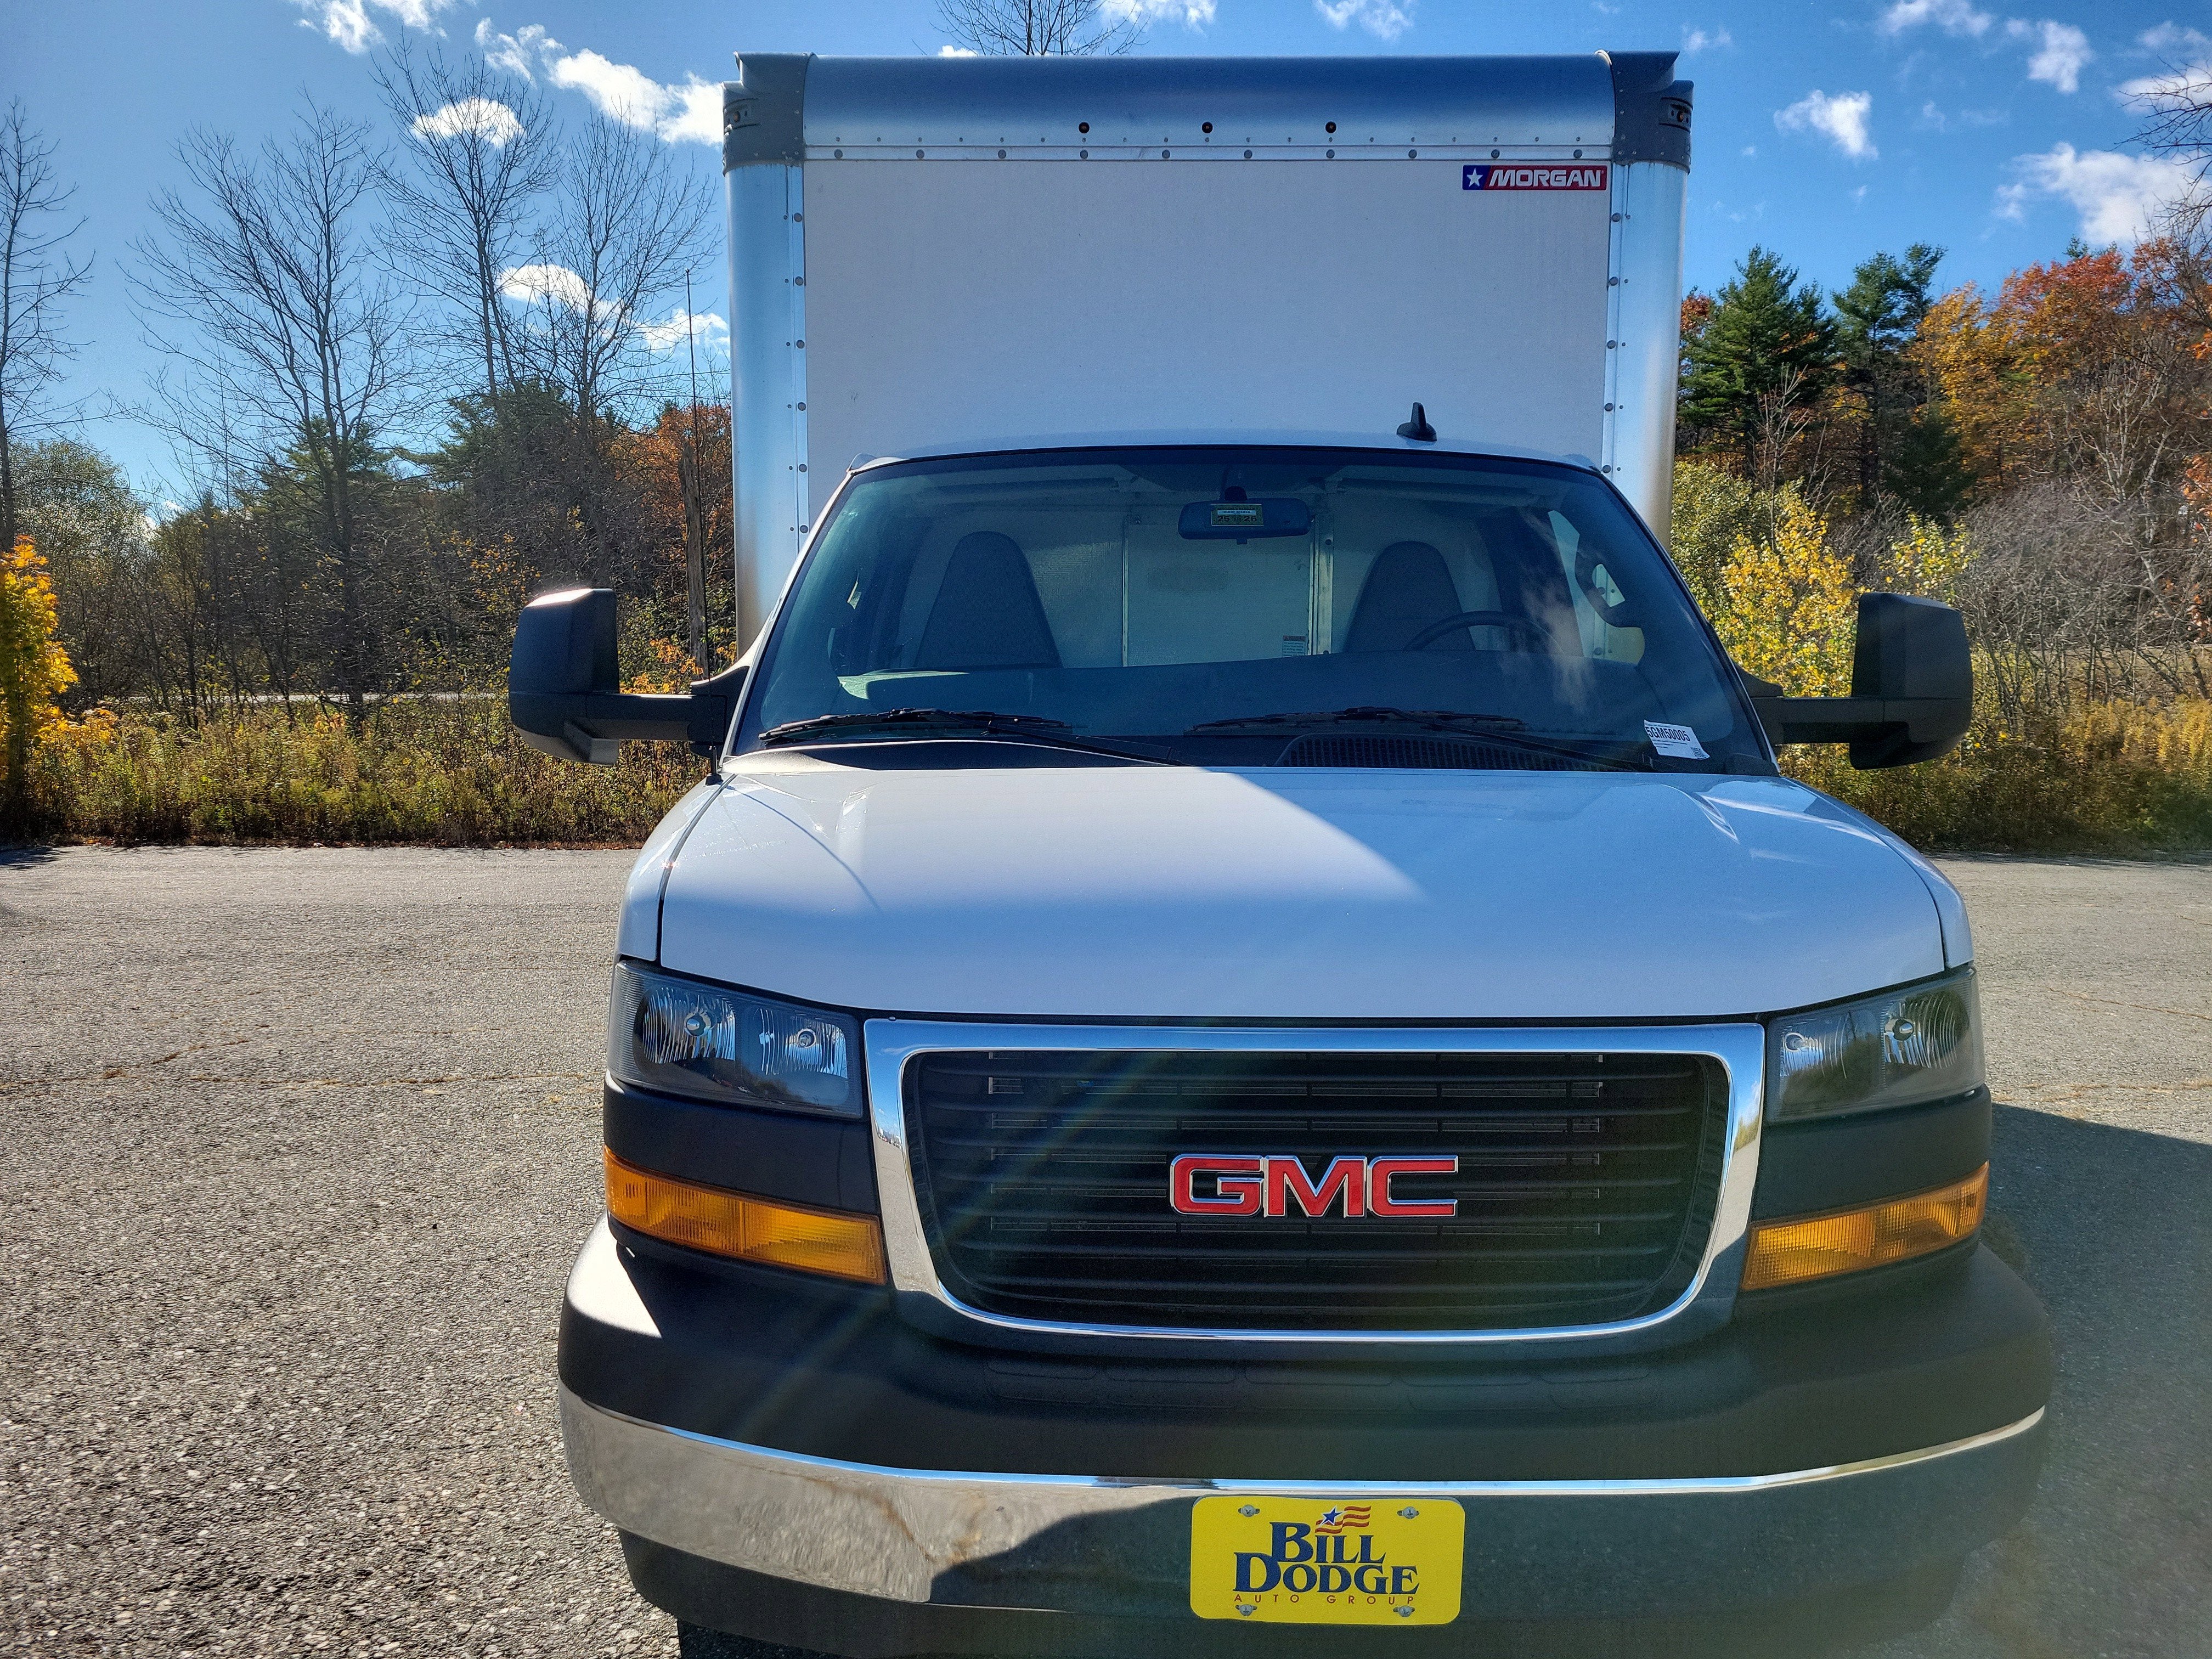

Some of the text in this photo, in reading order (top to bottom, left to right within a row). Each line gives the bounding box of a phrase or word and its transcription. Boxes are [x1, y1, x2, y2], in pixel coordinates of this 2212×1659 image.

[1488, 169, 1601, 187] MORGAN
[1645, 726, 1691, 742] 5GM50005
[1170, 1153, 1459, 1218] GMC
[1269, 1521, 1386, 1564] BILL
[1232, 1552, 1420, 1595] DODGE
[1233, 1594, 1415, 1605] AUTO GROUP
